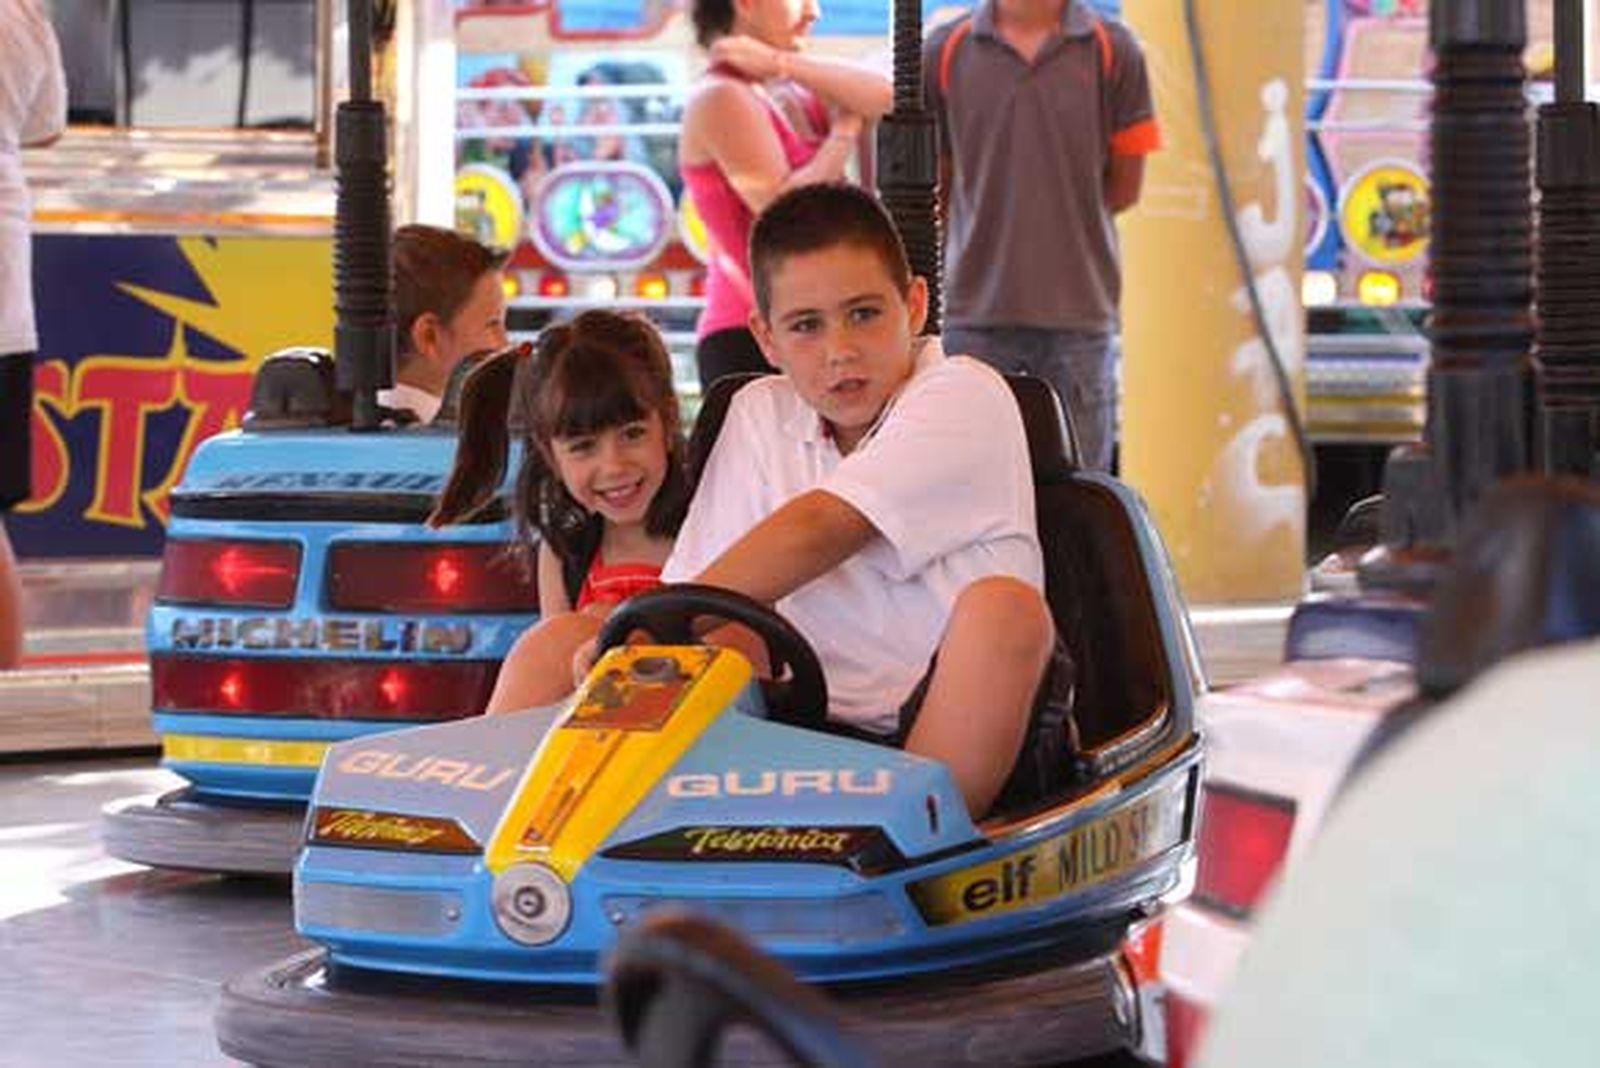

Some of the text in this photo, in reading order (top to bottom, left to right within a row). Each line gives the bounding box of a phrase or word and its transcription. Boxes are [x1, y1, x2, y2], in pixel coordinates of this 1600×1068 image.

[173, 619, 473, 653] MICHELIN
[338, 751, 512, 790] GURU
[667, 769, 893, 797] GURU
[962, 854, 1036, 911] elf
[1058, 820, 1122, 891] MILD
